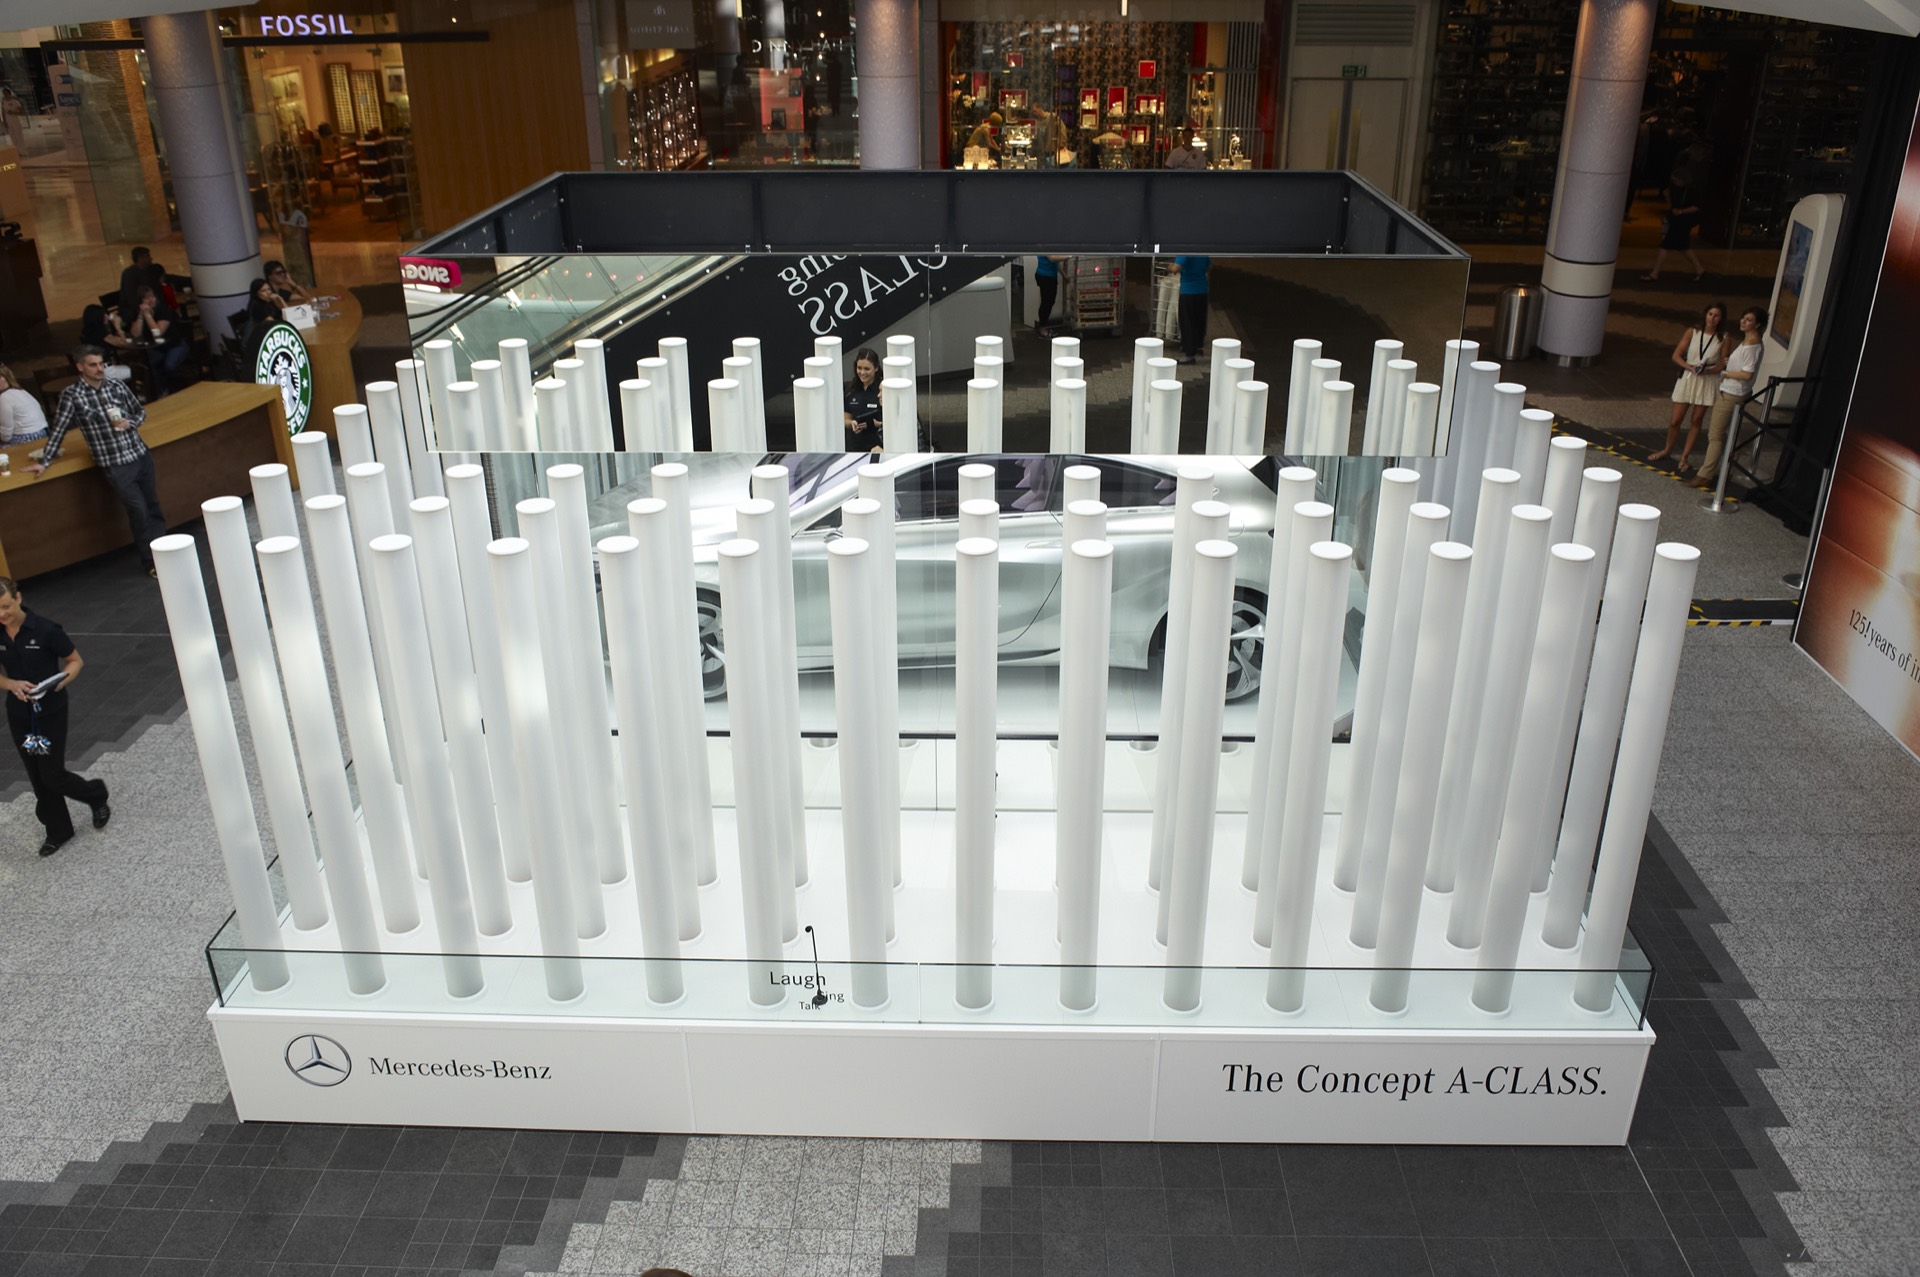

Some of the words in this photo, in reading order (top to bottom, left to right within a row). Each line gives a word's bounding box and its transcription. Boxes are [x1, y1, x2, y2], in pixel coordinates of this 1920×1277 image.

[260, 14, 353, 36] FOSSIL
[287, 400, 307, 434] FEE
[1849, 608, 1871, 638] 125!
[1868, 627, 1897, 662] years
[1898, 653, 1912, 672] of
[770, 971, 826, 989] Laugh
[368, 1057, 552, 1080] Mercedes-Benz
[1222, 1064, 1283, 1092] The
[1297, 1064, 1436, 1101] Concept
[1444, 1066, 1607, 1095] A-CLASS.
